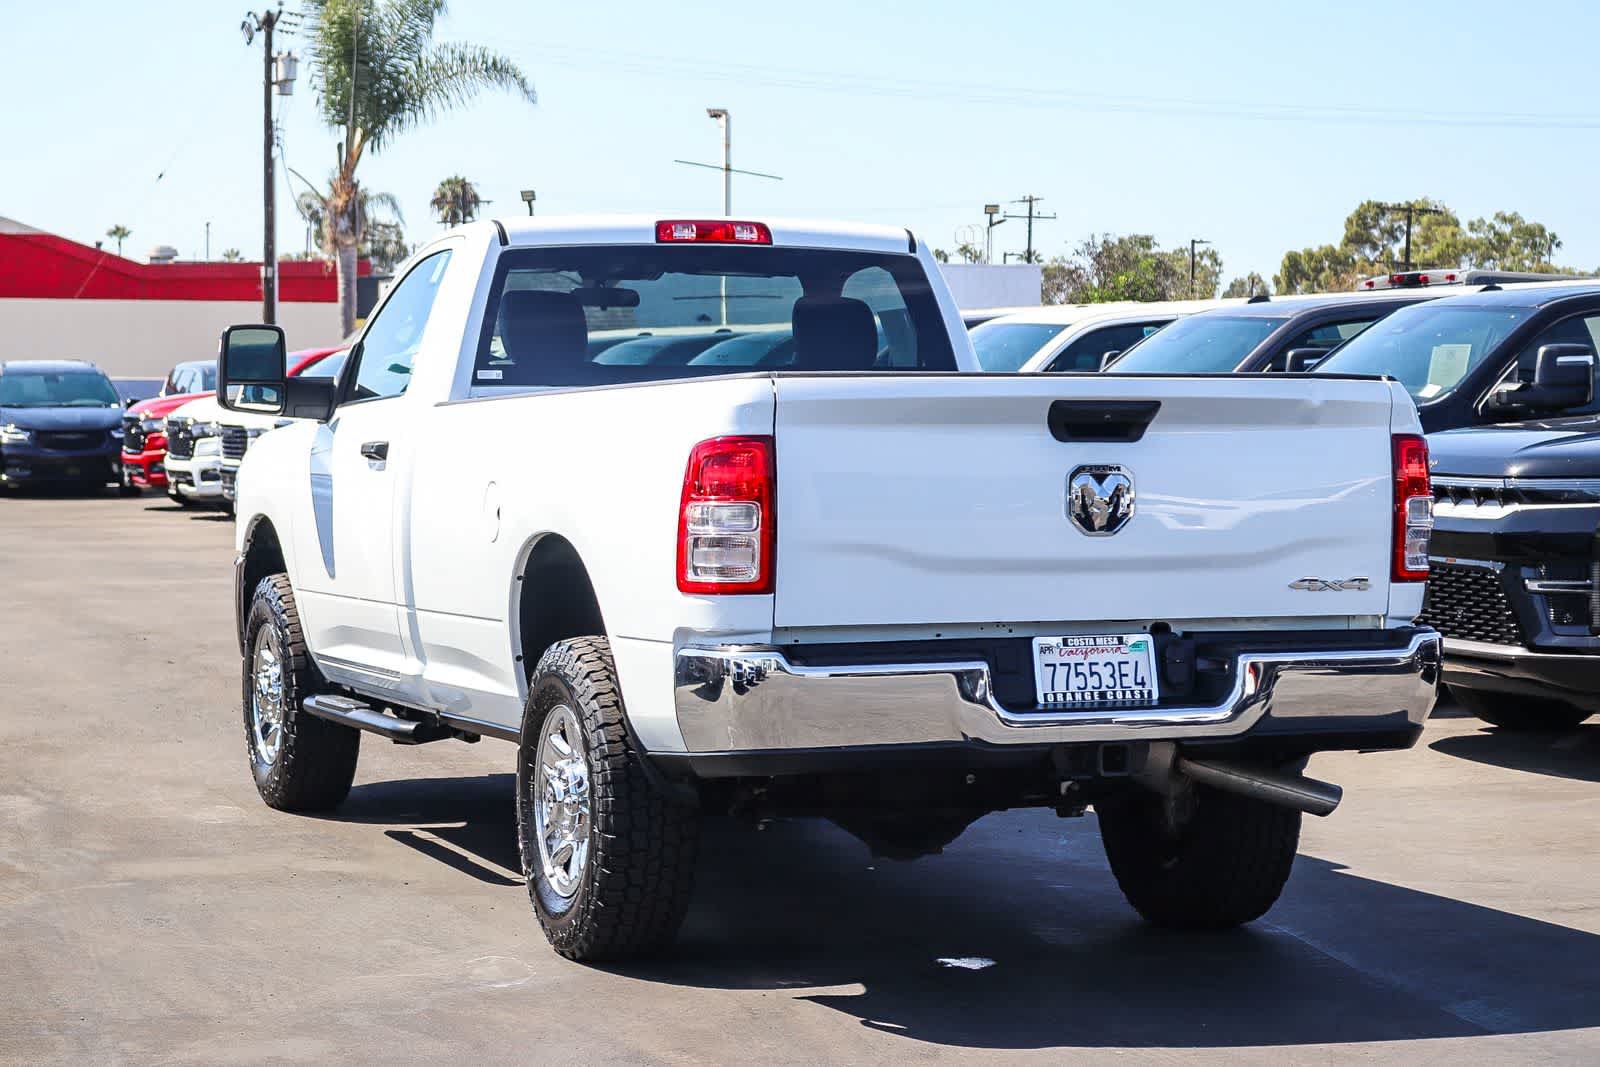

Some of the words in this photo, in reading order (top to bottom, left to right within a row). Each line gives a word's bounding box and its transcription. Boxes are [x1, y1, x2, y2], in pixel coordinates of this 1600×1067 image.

[1068, 638, 1095, 647] COSTA
[1096, 637, 1119, 646] MESA
[1039, 645, 1054, 655] APR
[1058, 647, 1128, 660] California
[1044, 661, 1146, 691] 77553E4
[1047, 691, 1100, 702] ORANGE
[1107, 690, 1149, 700] COAST
